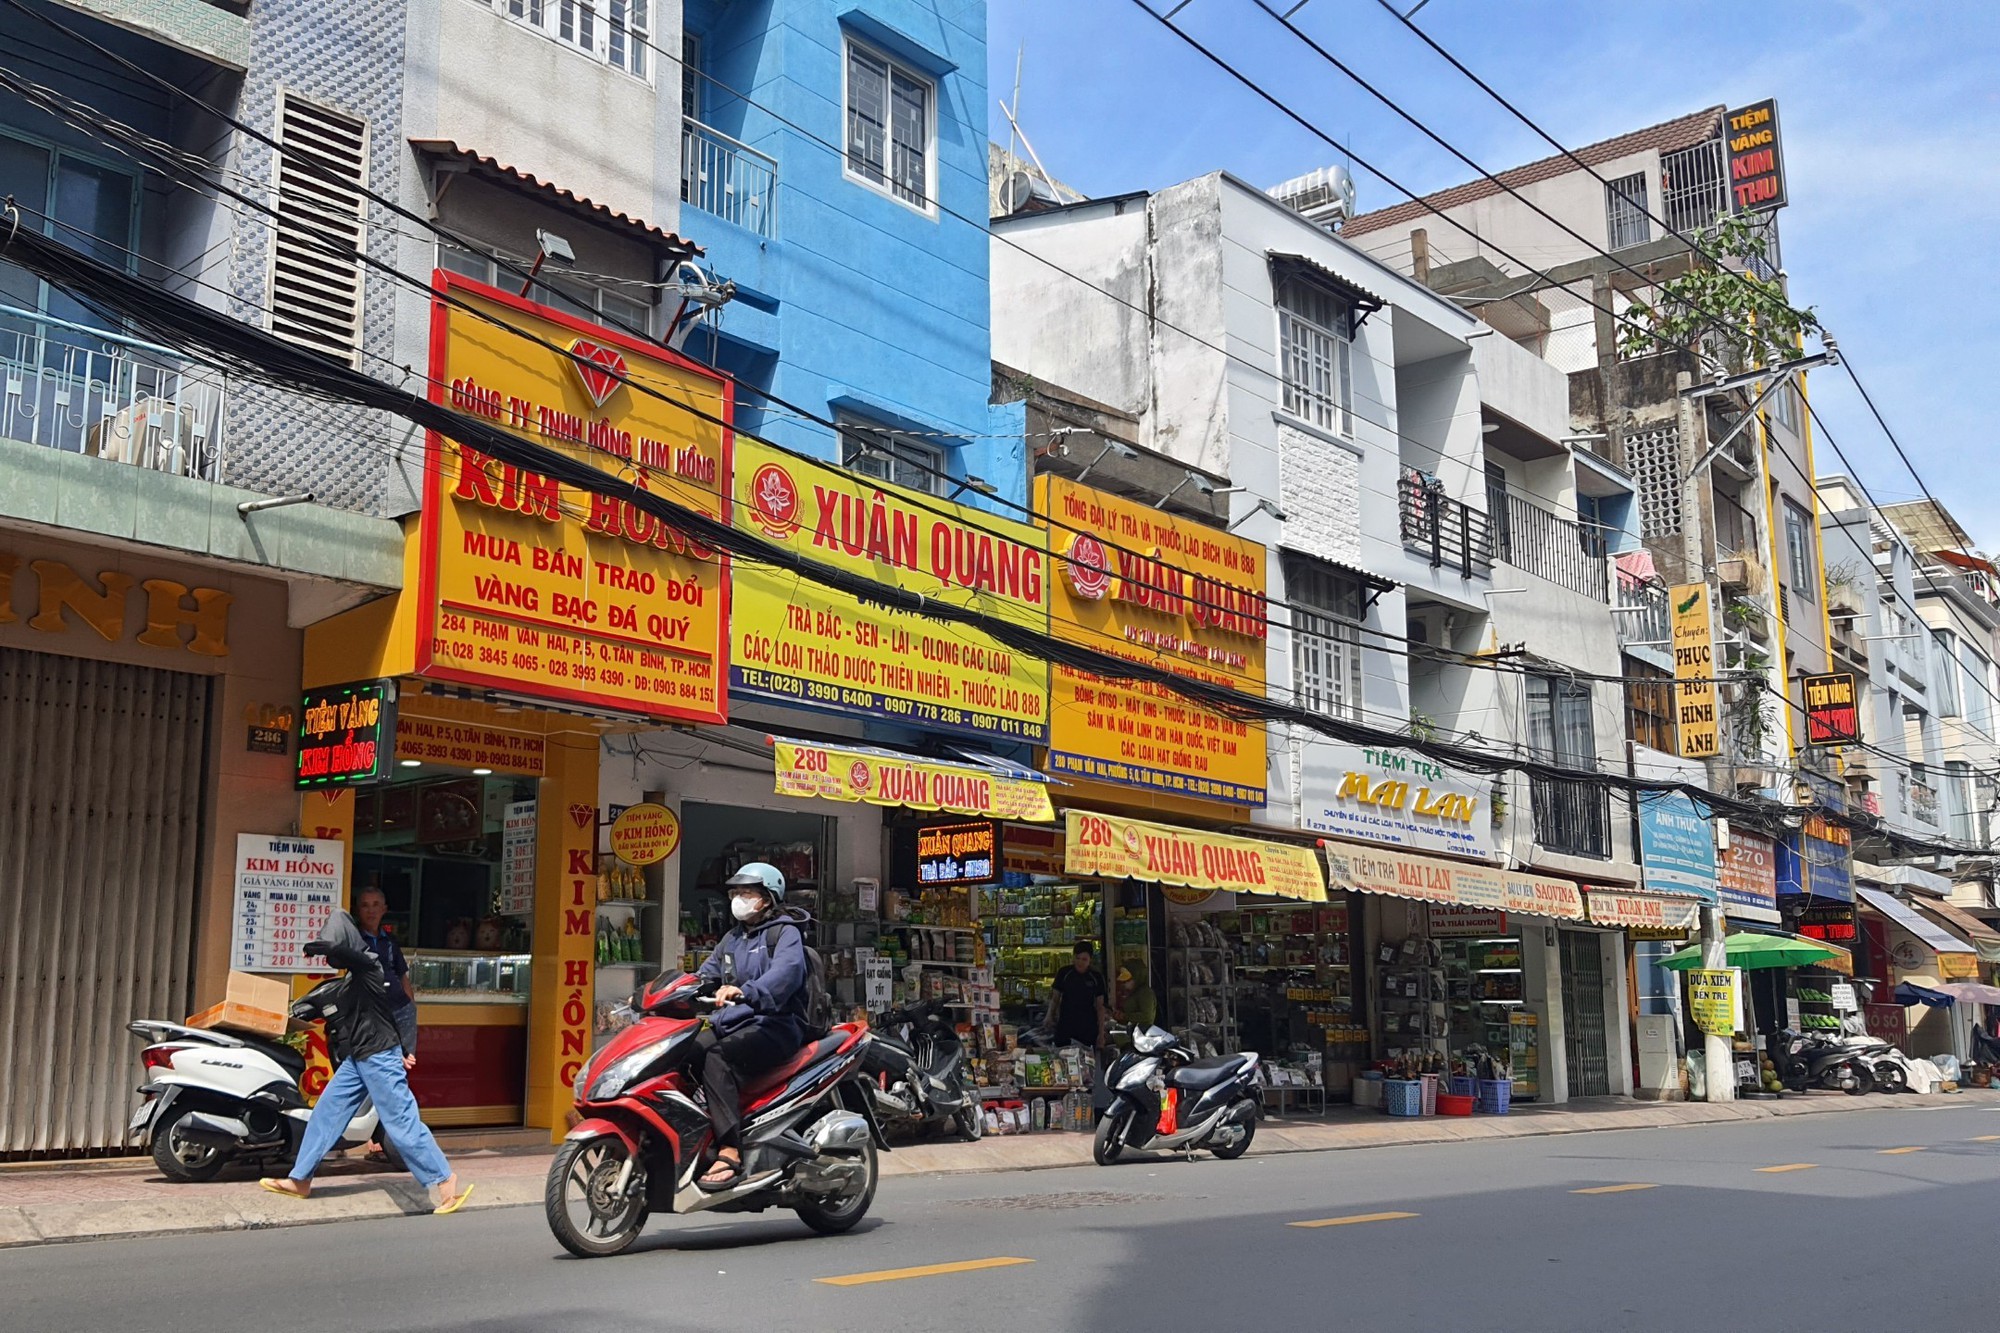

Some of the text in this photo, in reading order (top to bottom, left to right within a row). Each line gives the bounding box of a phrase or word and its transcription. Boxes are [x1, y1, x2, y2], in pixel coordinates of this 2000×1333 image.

[1730, 108, 1770, 130] TIỆM
[1732, 149, 1774, 180] KIM
[1734, 176, 1778, 207] THU
[451, 376, 715, 485] CÔNG TY TNHH HỒNG KIM HỒNG
[452, 443, 563, 523] KIM
[813, 485, 919, 572] XUÂN
[930, 521, 1042, 605] QUANG
[1121, 514, 1256, 575] TRÀ BÍCH 888
[463, 530, 703, 608] MUA BÁN TRAO ĐỔI
[1117, 547, 1268, 640] XUÂN QUANG
[474, 573, 690, 642] VÀNG BẠC ĐÁ QUÝ
[441, 613, 540, 647] 284 PHẠM VĂN
[787, 602, 1012, 681] TRÀ BẮC SEN LÀI OLONG CÁC LOẠI
[1675, 645, 1711, 669] PHỤC
[452, 643, 714, 703] 028 3845 4065 028 3993 4390 0903 884 151
[743, 629, 1040, 716] CÁC LOẠI THẢO DƯỢC THIÊN NHIÊN THUỐC LÀO 888
[1098, 691, 1157, 718] ATISO ONG
[1808, 678, 1851, 710] TIỆM VÀNG
[306, 699, 337, 740] TIỆM
[807, 682, 839, 702] 3990
[842, 690, 873, 708] 6400
[884, 698, 914, 715] 0907
[916, 703, 938, 720] 778
[940, 708, 961, 724] 286
[971, 712, 998, 730] 0907
[1000, 718, 1020, 734] 011
[1022, 722, 1042, 739] 848
[1681, 701, 1714, 725] HÌNH
[254, 729, 282, 743] 286
[1137, 722, 1237, 756] LINH CHI NAM
[1685, 728, 1714, 754] ẢNH
[300, 746, 329, 776] KIM
[794, 747, 828, 773] 280
[1121, 739, 1208, 772] CÁC RAU
[1362, 749, 1442, 782] TIỆM TRÀ
[878, 763, 927, 803] XUÂN
[932, 773, 991, 811] QUANG
[1336, 770, 1478, 822] MAI LAN
[623, 827, 643, 840] KIM
[919, 830, 991, 857] XUÂN QUANG
[1079, 815, 1112, 848] 280
[246, 855, 334, 875] KIM HỒNG
[631, 849, 655, 860] 284
[1144, 831, 1198, 878] XUÂN
[1201, 843, 1266, 885] QUANG
[1733, 846, 1764, 866] 270
[920, 857, 937, 880] TRÀ
[1352, 853, 1376, 880] TIỆM
[1377, 858, 1395, 880] TRÀ
[1396, 862, 1423, 888] MAI
[1425, 866, 1451, 891] LAN
[269, 892, 285, 900] MUA
[316, 880, 335, 890] NAY
[564, 849, 593, 936] KIM
[1535, 882, 1577, 904] SAOVINA
[274, 902, 296, 914] 606
[308, 904, 331, 914] 616
[1616, 896, 1642, 916] XUÂN
[1644, 900, 1662, 916] ANH
[273, 929, 296, 940] 400
[274, 916, 296, 927] 597
[1827, 924, 1855, 939] THU
[271, 955, 294, 966] 280
[273, 942, 295, 953] 338
[306, 956, 328, 967] 316
[1711, 992, 1728, 1000] TRE
[200, 1059, 243, 1069] LEAD
